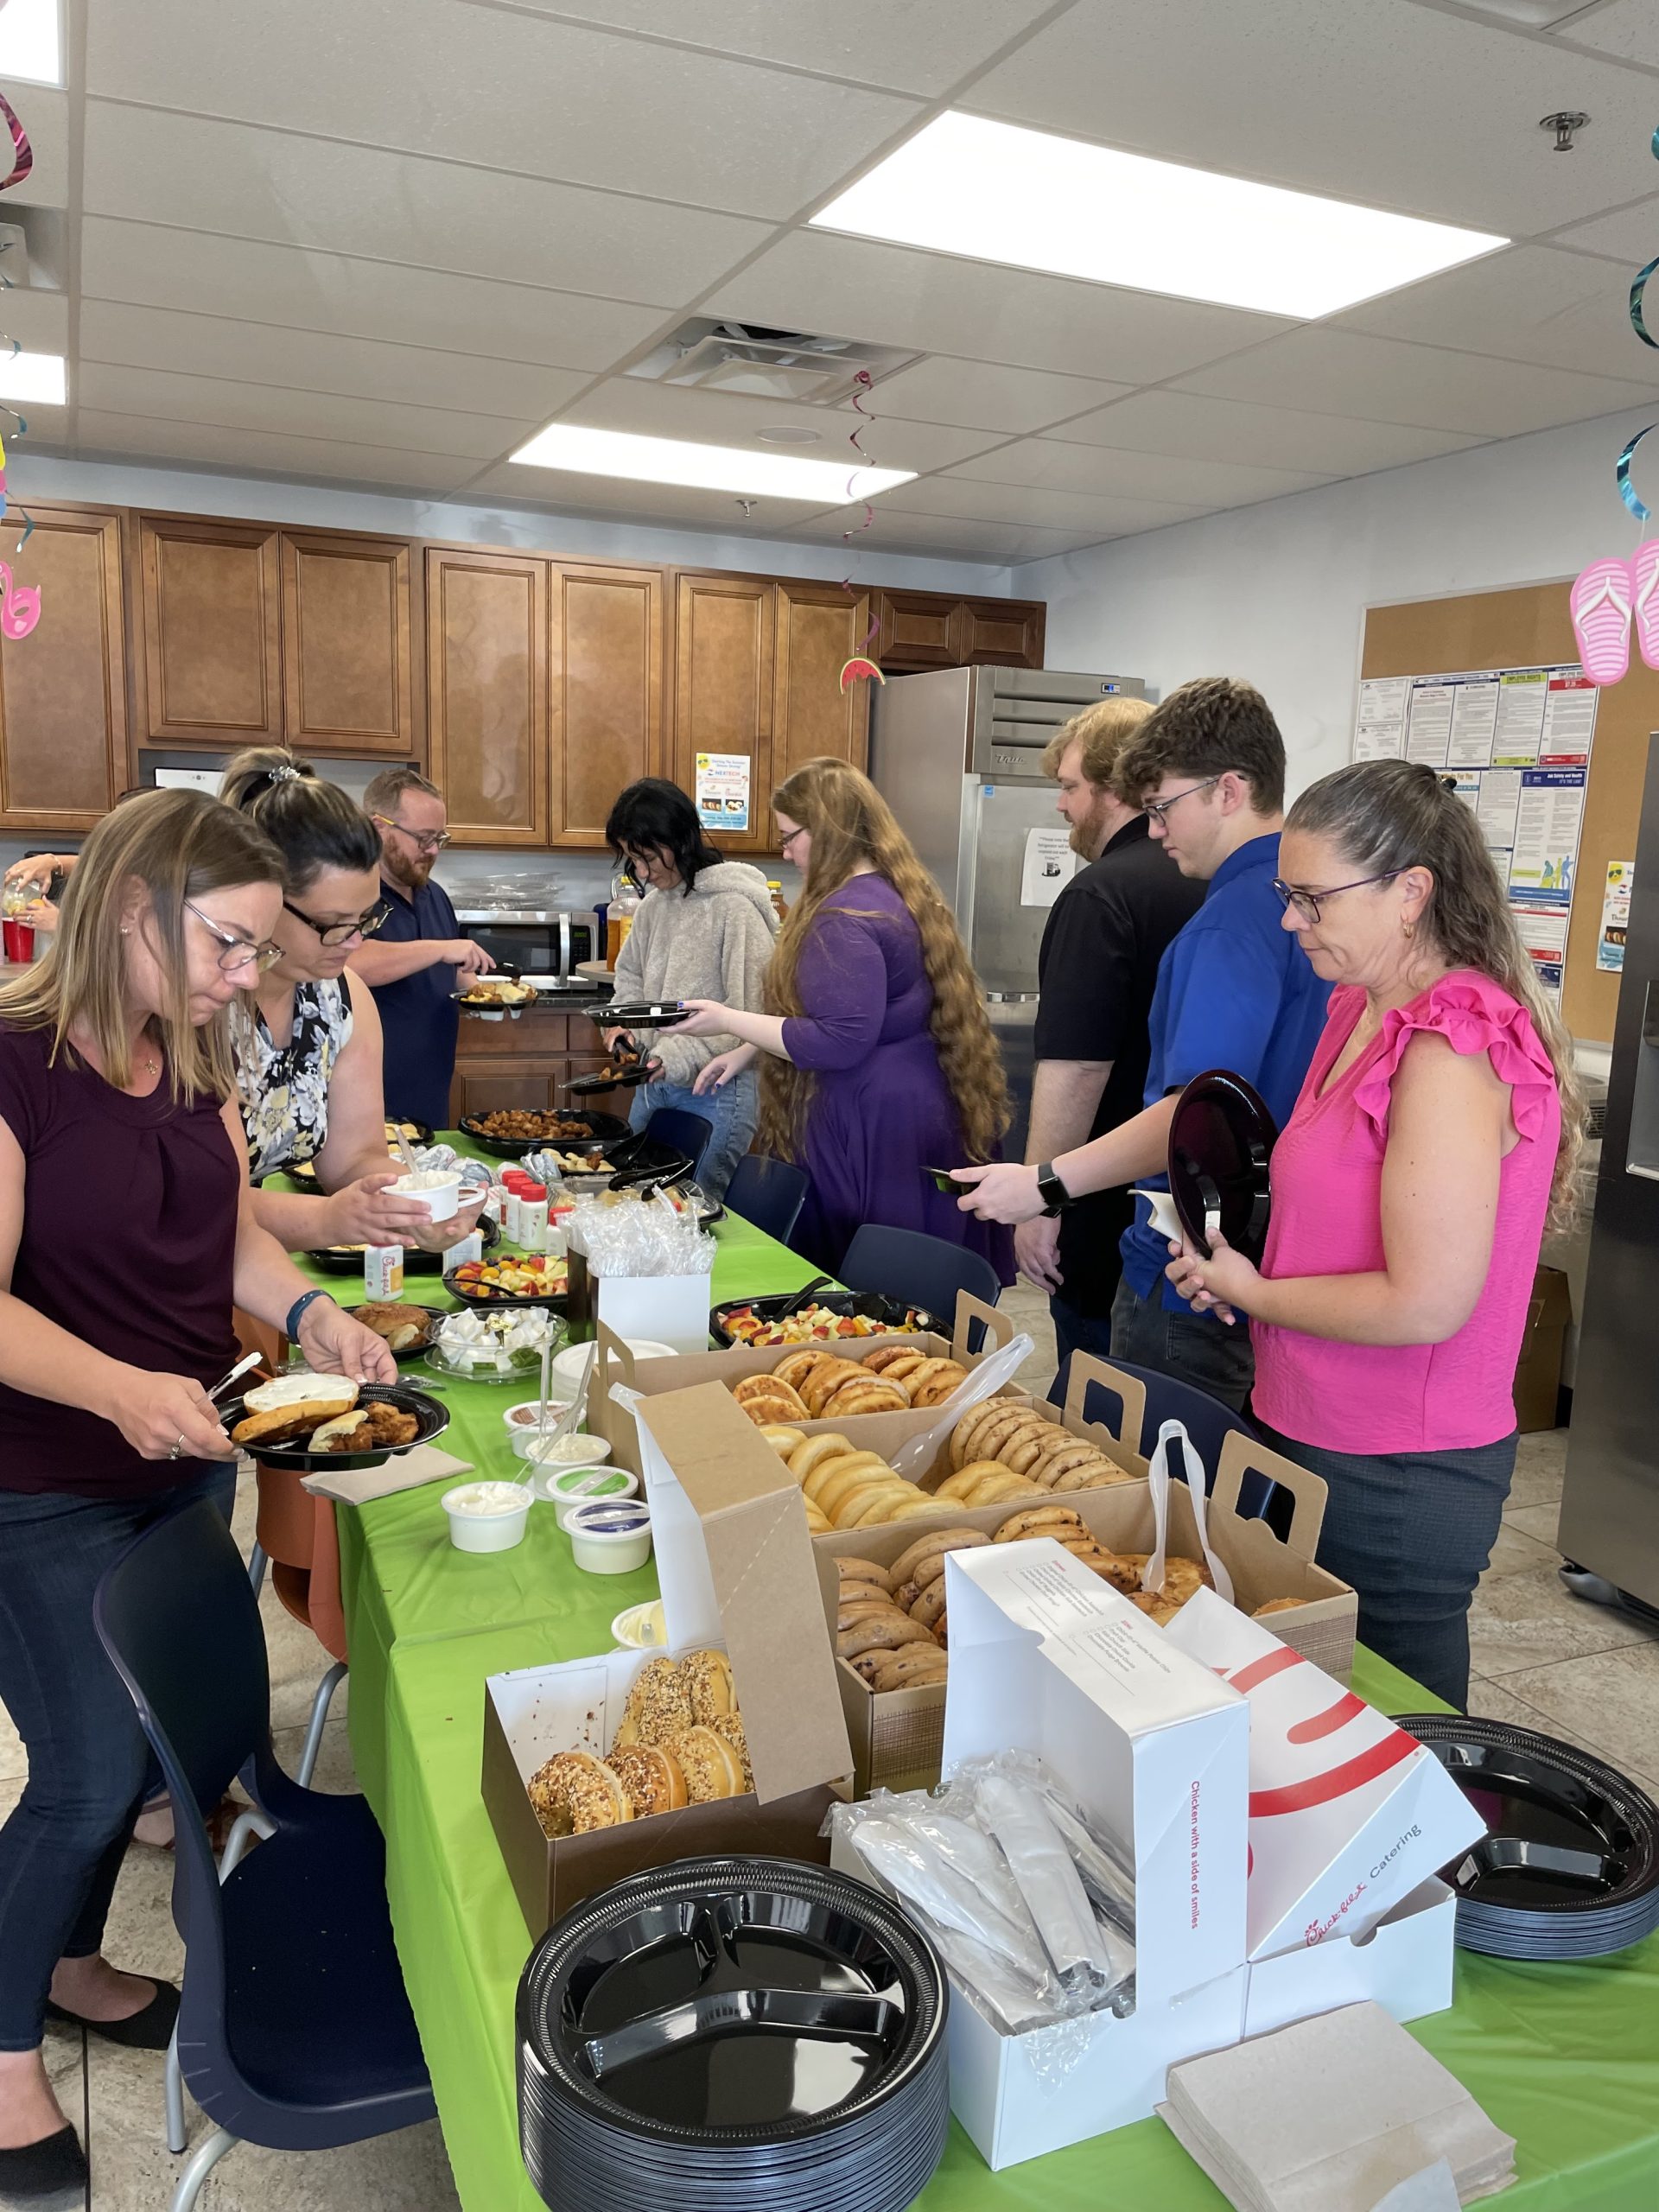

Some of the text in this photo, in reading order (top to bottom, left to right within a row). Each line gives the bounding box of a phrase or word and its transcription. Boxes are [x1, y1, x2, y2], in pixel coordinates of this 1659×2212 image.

[1191, 1781, 1200, 1825] Chicken
[1191, 1826, 1200, 1850] with
[1370, 1824, 1422, 1879] Catering
[1191, 1859, 1200, 1882] side
[1191, 1883, 1200, 1895] of
[1191, 1896, 1200, 1929] smiles
